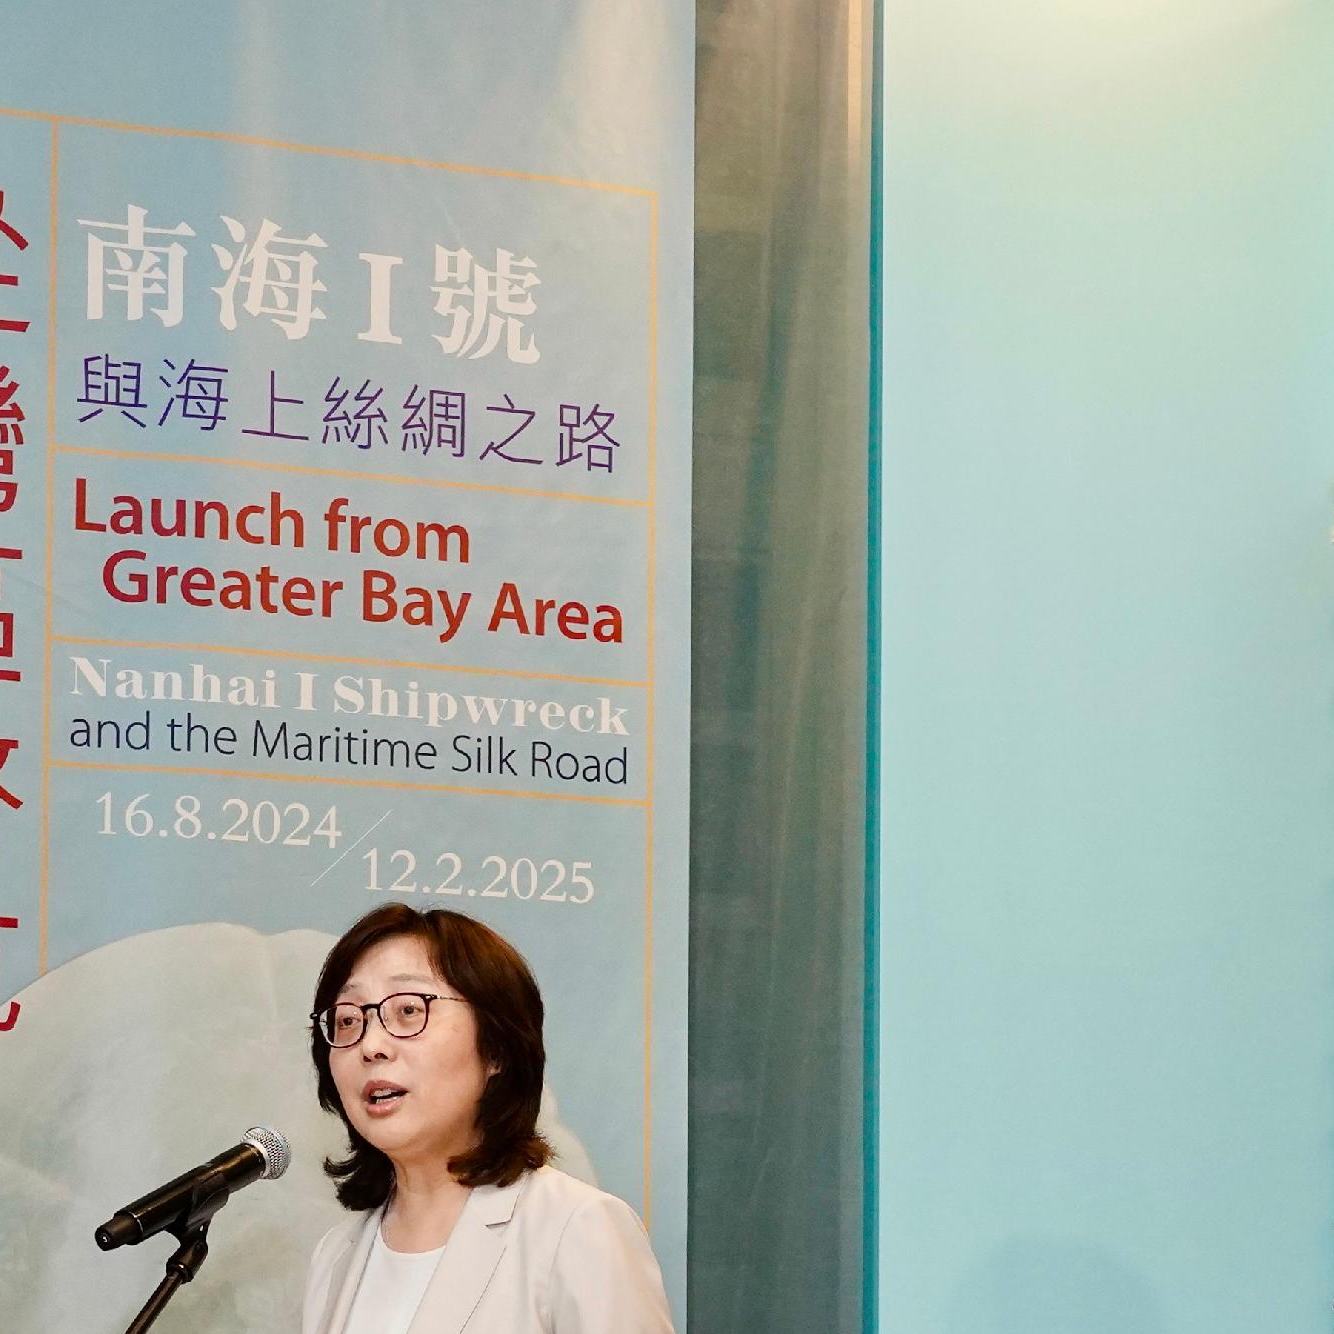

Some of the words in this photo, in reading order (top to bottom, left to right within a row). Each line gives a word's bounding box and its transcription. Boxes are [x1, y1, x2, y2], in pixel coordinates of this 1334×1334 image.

[76, 353, 620, 474] 與海上絲綢之路
[75, 478, 304, 546] Launch
[324, 498, 470, 563] from
[102, 549, 344, 620] Greater
[362, 569, 472, 644] Bay
[488, 582, 623, 644] Area
[69, 656, 278, 709] Nanhai
[293, 672, 319, 712] I
[332, 672, 631, 737] Shipwreck
[70, 711, 151, 752] and
[167, 713, 239, 756] the
[252, 719, 438, 771] Maritime
[451, 734, 519, 777] Silk
[531, 741, 628, 785] Road
